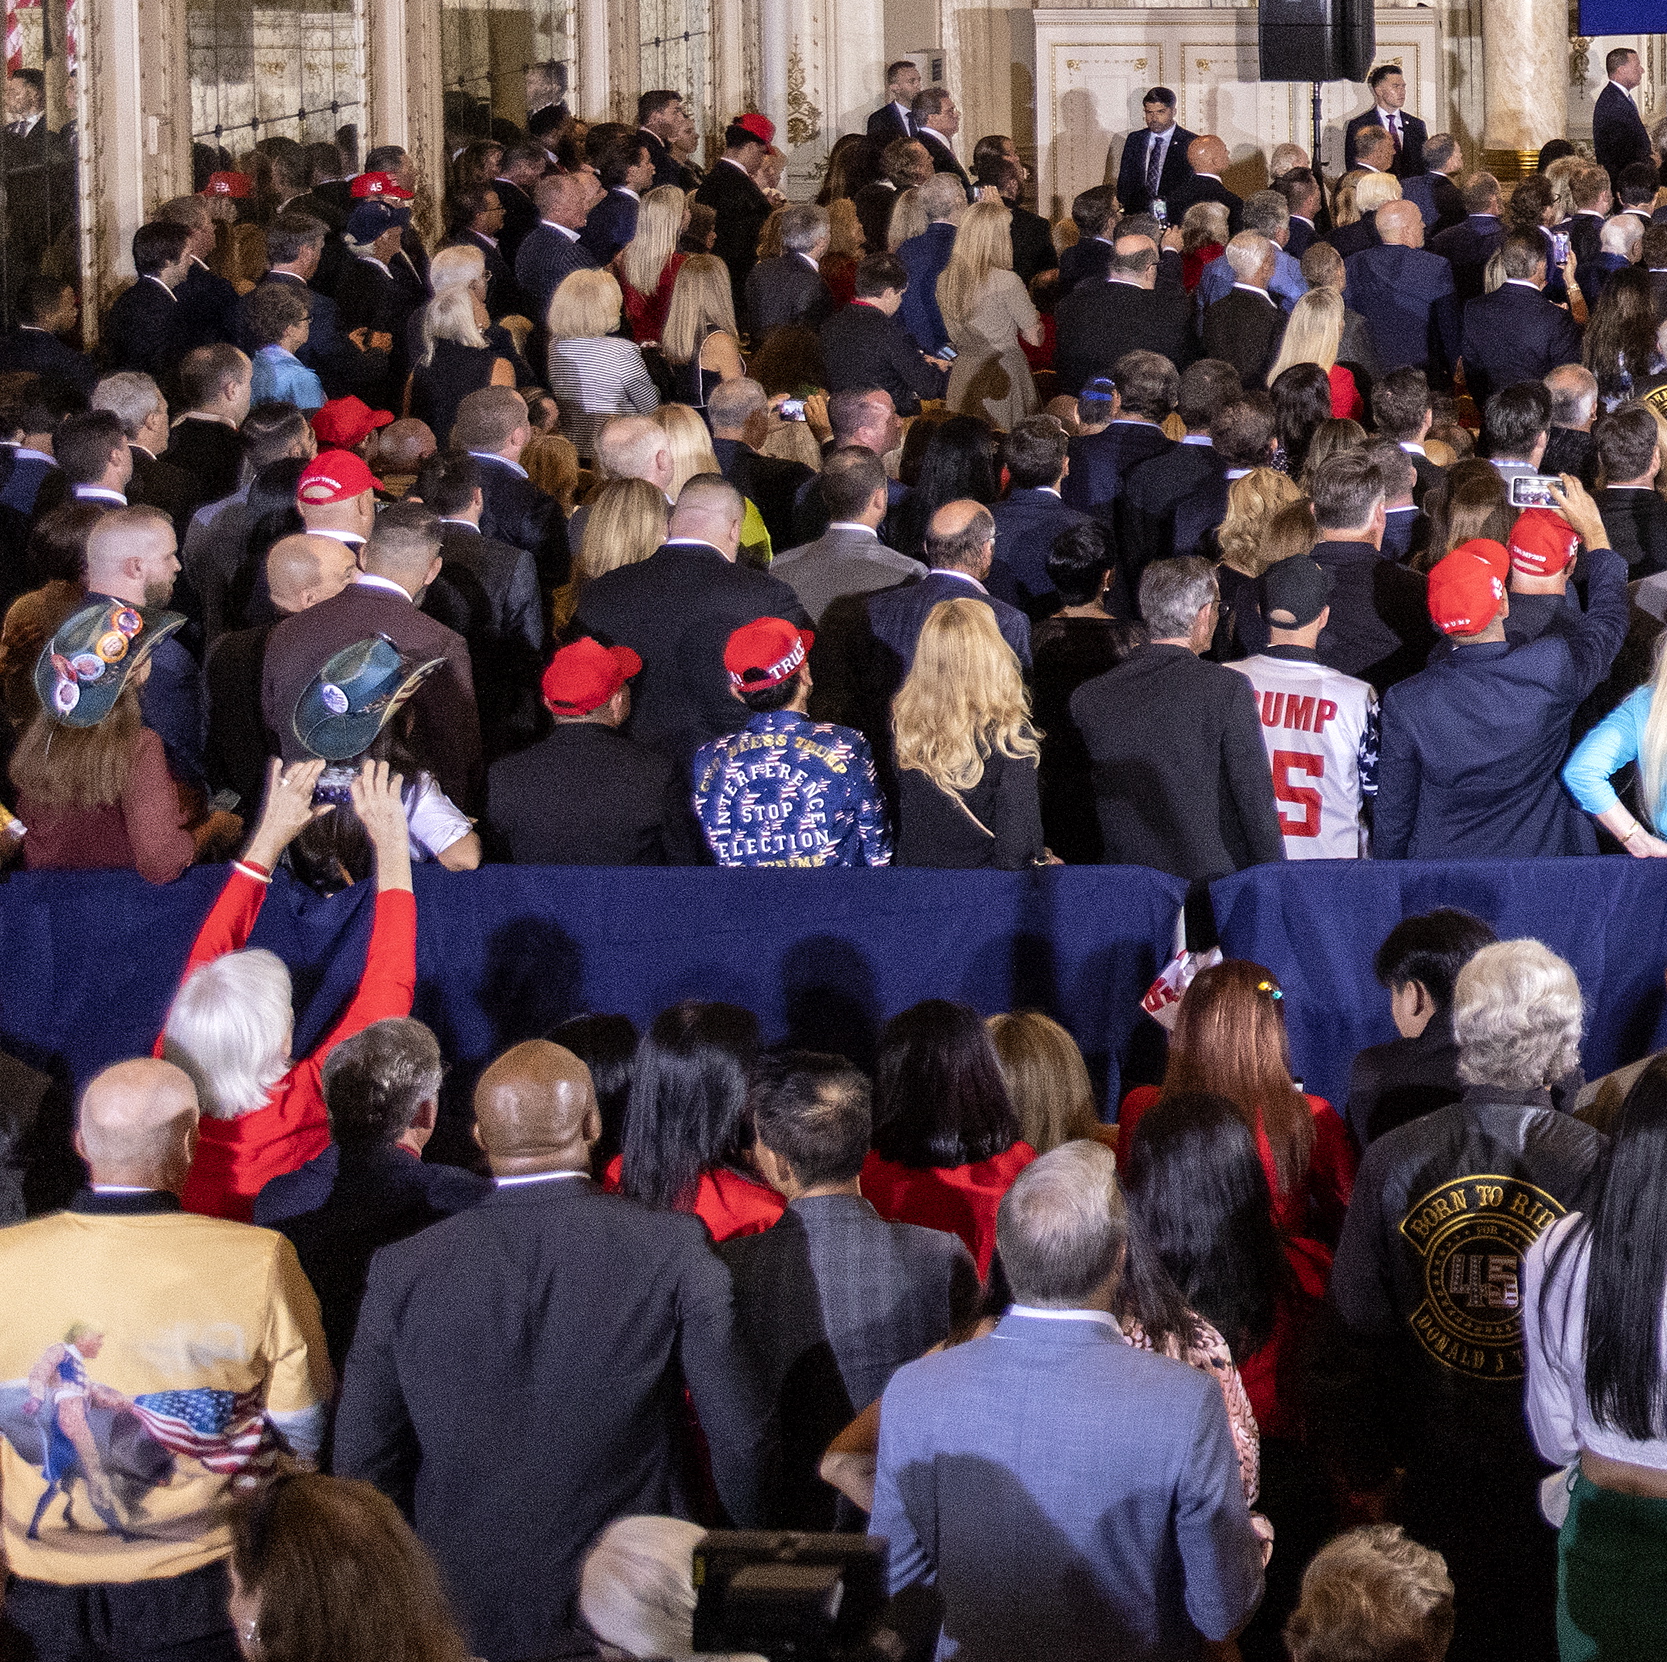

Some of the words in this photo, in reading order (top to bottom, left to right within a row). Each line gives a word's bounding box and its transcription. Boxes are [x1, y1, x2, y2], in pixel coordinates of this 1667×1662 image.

[370, 182, 383, 192] 45
[1443, 618, 1472, 629] RUMP
[1254, 690, 1339, 734] UMP
[717, 762, 827, 836] INTERFERENCE
[741, 802, 794, 823] STOP
[718, 829, 830, 859] ELECTION
[1411, 1188, 1468, 1237] BORN
[1475, 1184, 1505, 1207] TO
[1509, 1192, 1557, 1229] RID
[1449, 1253, 1520, 1309] 45
[1418, 1314, 1485, 1369] DONALD
